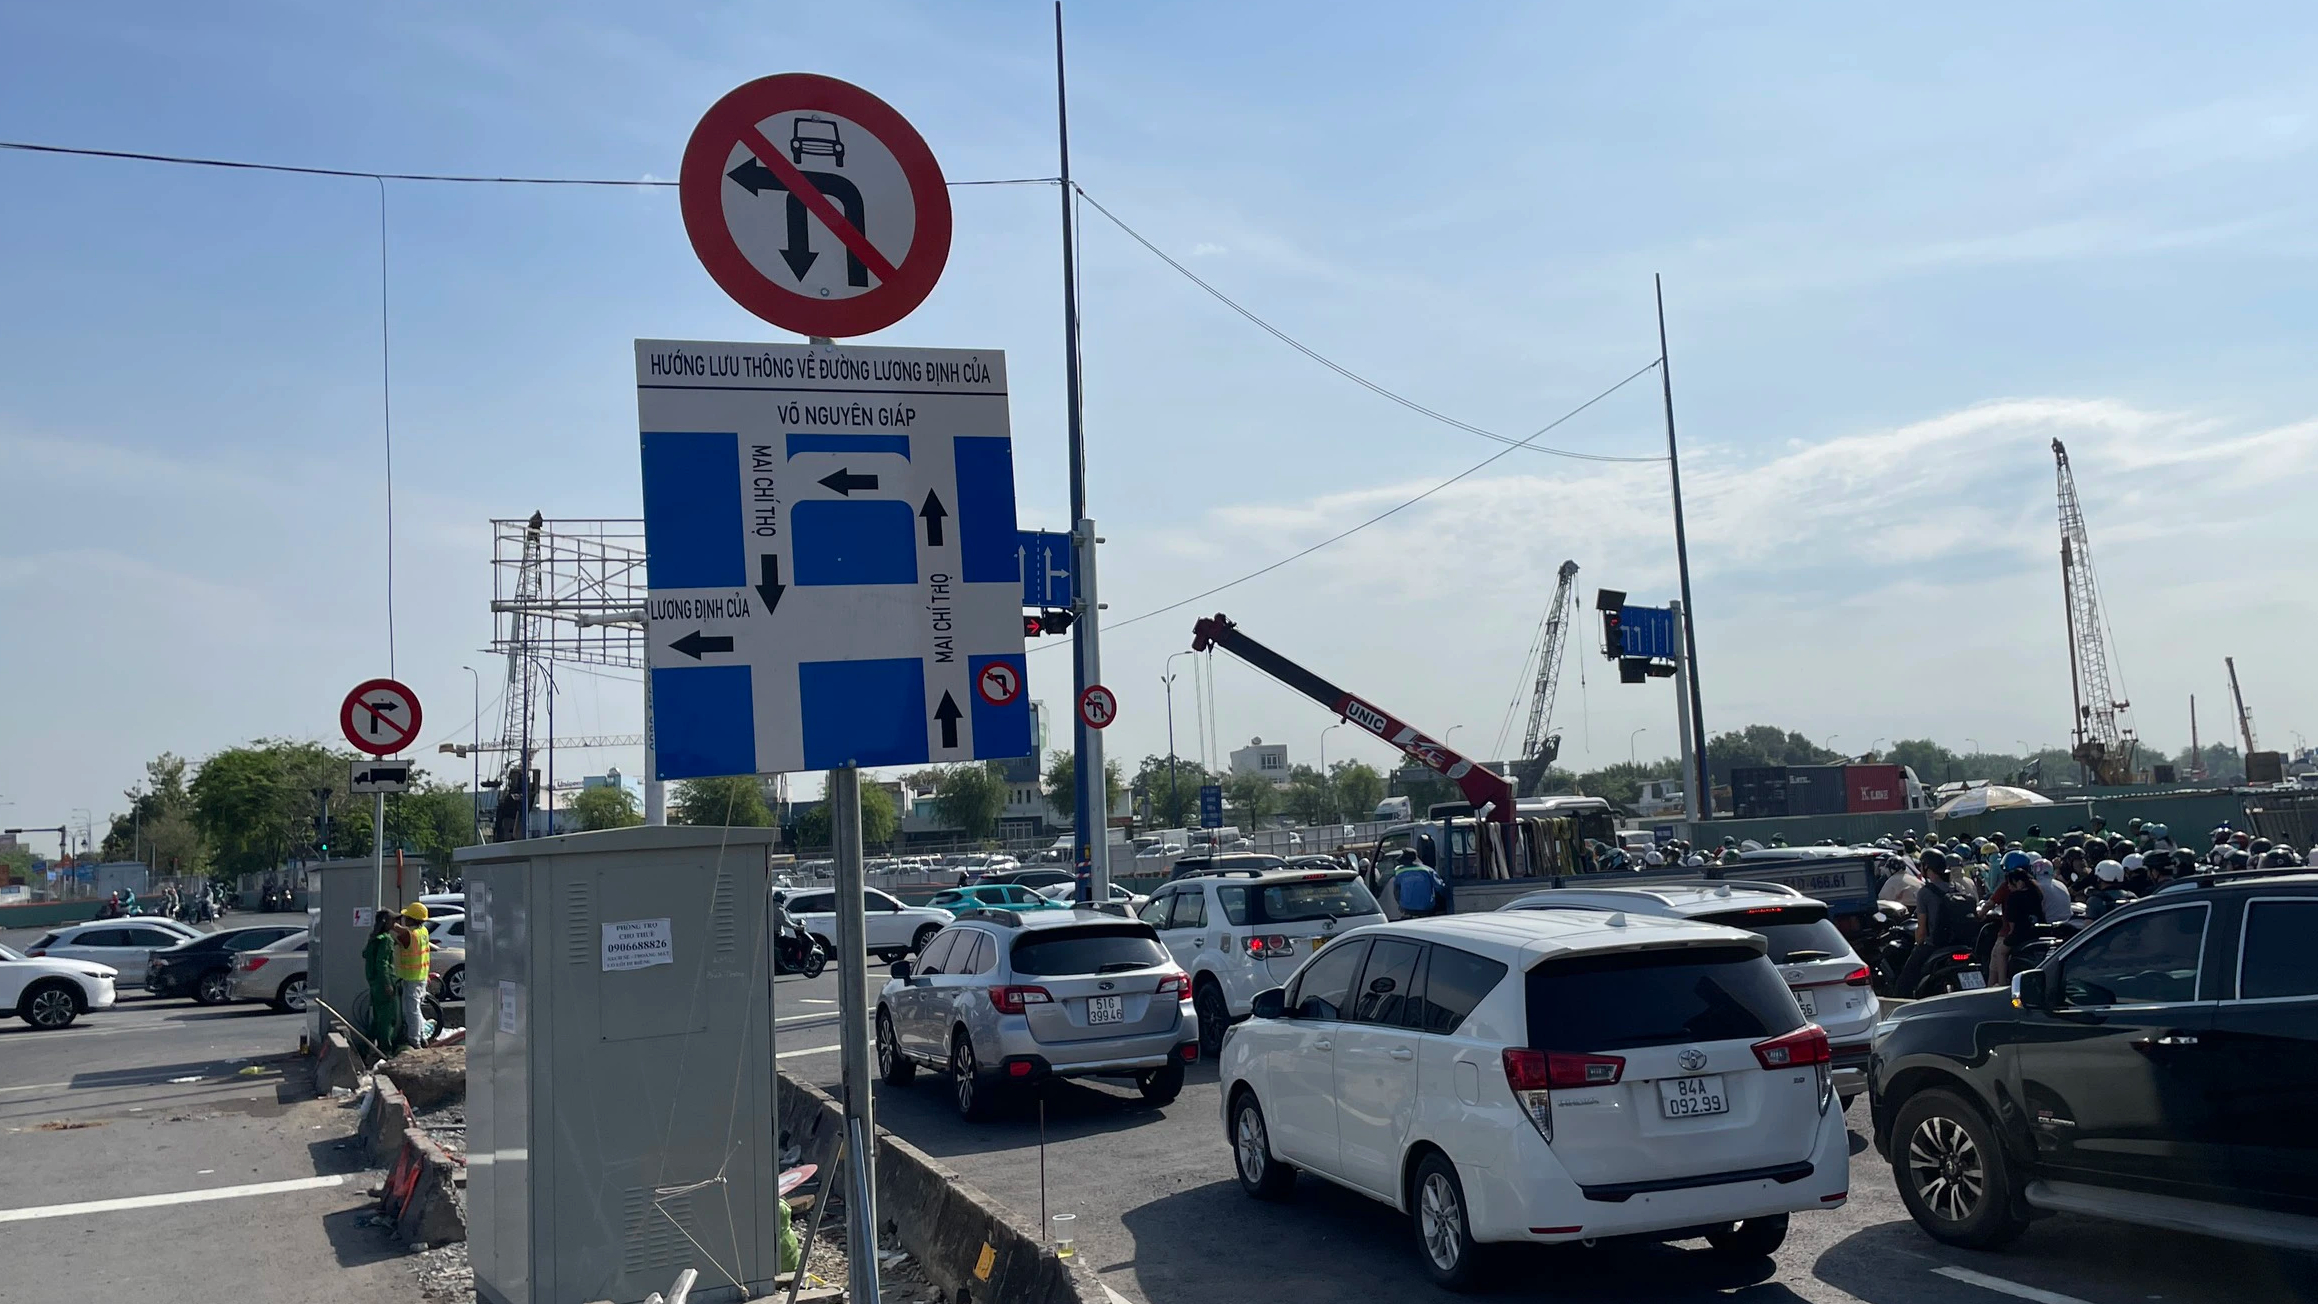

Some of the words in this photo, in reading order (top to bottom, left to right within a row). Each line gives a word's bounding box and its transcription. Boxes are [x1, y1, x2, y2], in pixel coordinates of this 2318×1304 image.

[651, 349, 705, 376] HƯỚNG
[709, 354, 740, 377] LƯU
[743, 352, 794, 378] THÔNG
[797, 350, 816, 379] VỀ
[819, 354, 870, 381] ĐƯỜNG
[873, 359, 922, 382] LƯƠNG
[926, 362, 960, 386] ĐỊNH
[963, 356, 991, 384] CỦA
[777, 401, 800, 425] VÕ
[805, 402, 873, 426] NGUYÊN
[878, 402, 916, 427] GIÁP
[751, 445, 773, 472] MAI
[753, 477, 781, 504] CHÍ
[751, 506, 776, 537] THỌ
[930, 573, 953, 603] THỌ
[650, 598, 692, 620] LƯƠNG
[695, 598, 724, 623] ĐỊNH
[726, 592, 751, 618] CỦA
[926, 606, 952, 631] CHÍ
[934, 636, 954, 663] MAI
[1348, 703, 1384, 731] UNIC
[608, 940, 667, 953] 0906688826
[1096, 998, 1114, 1010] 51G
[1678, 1079, 1707, 1096] 84A
[1670, 1095, 1721, 1115] 092.99
